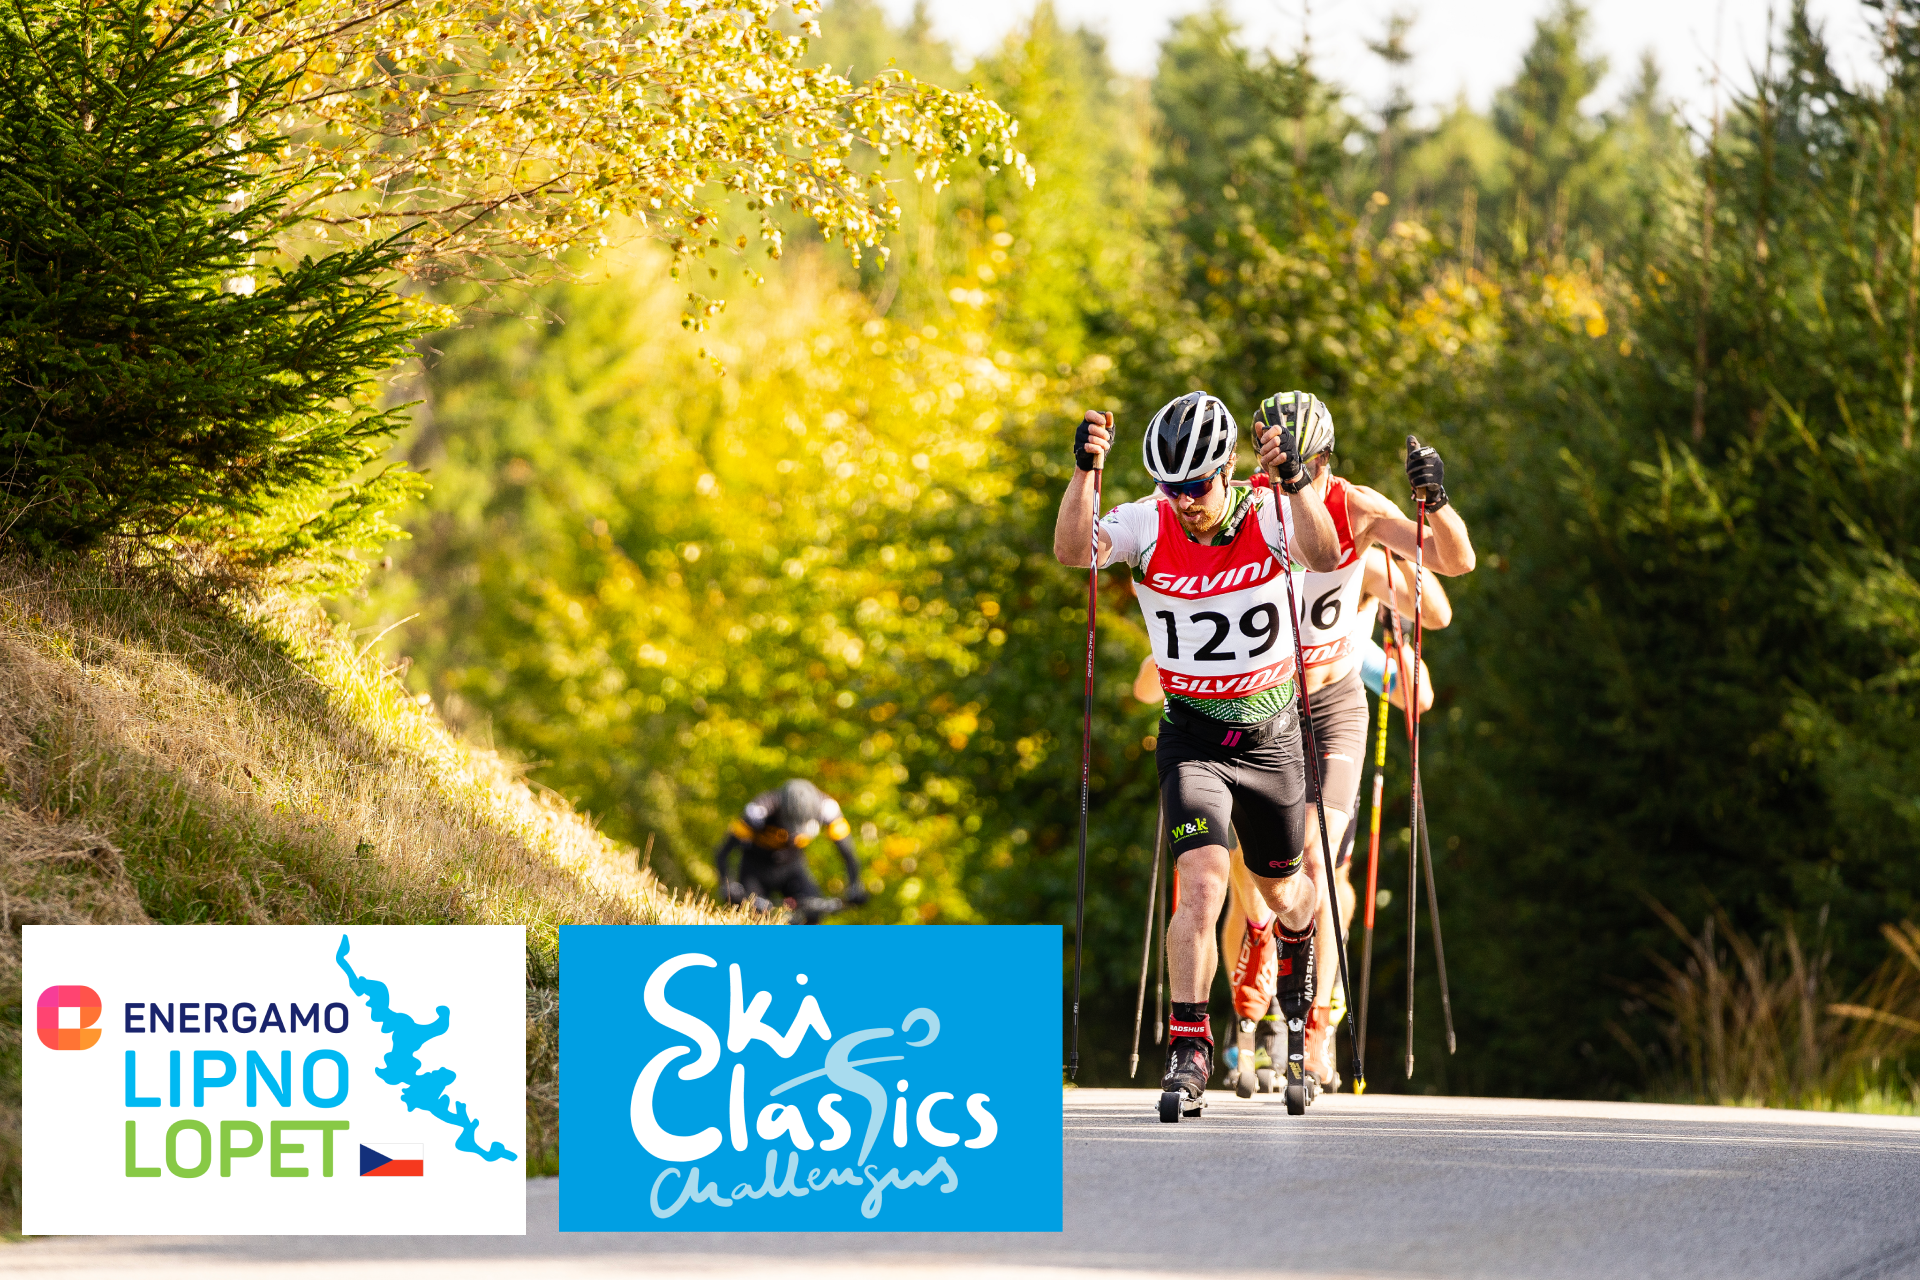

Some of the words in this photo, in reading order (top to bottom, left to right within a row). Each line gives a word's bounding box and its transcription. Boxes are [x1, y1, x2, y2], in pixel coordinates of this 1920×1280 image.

[1090, 489, 1101, 576] SWIX
[1151, 556, 1273, 595] SILVINI
[1155, 602, 1280, 662] 129
[1170, 664, 1284, 693] SILVINI
